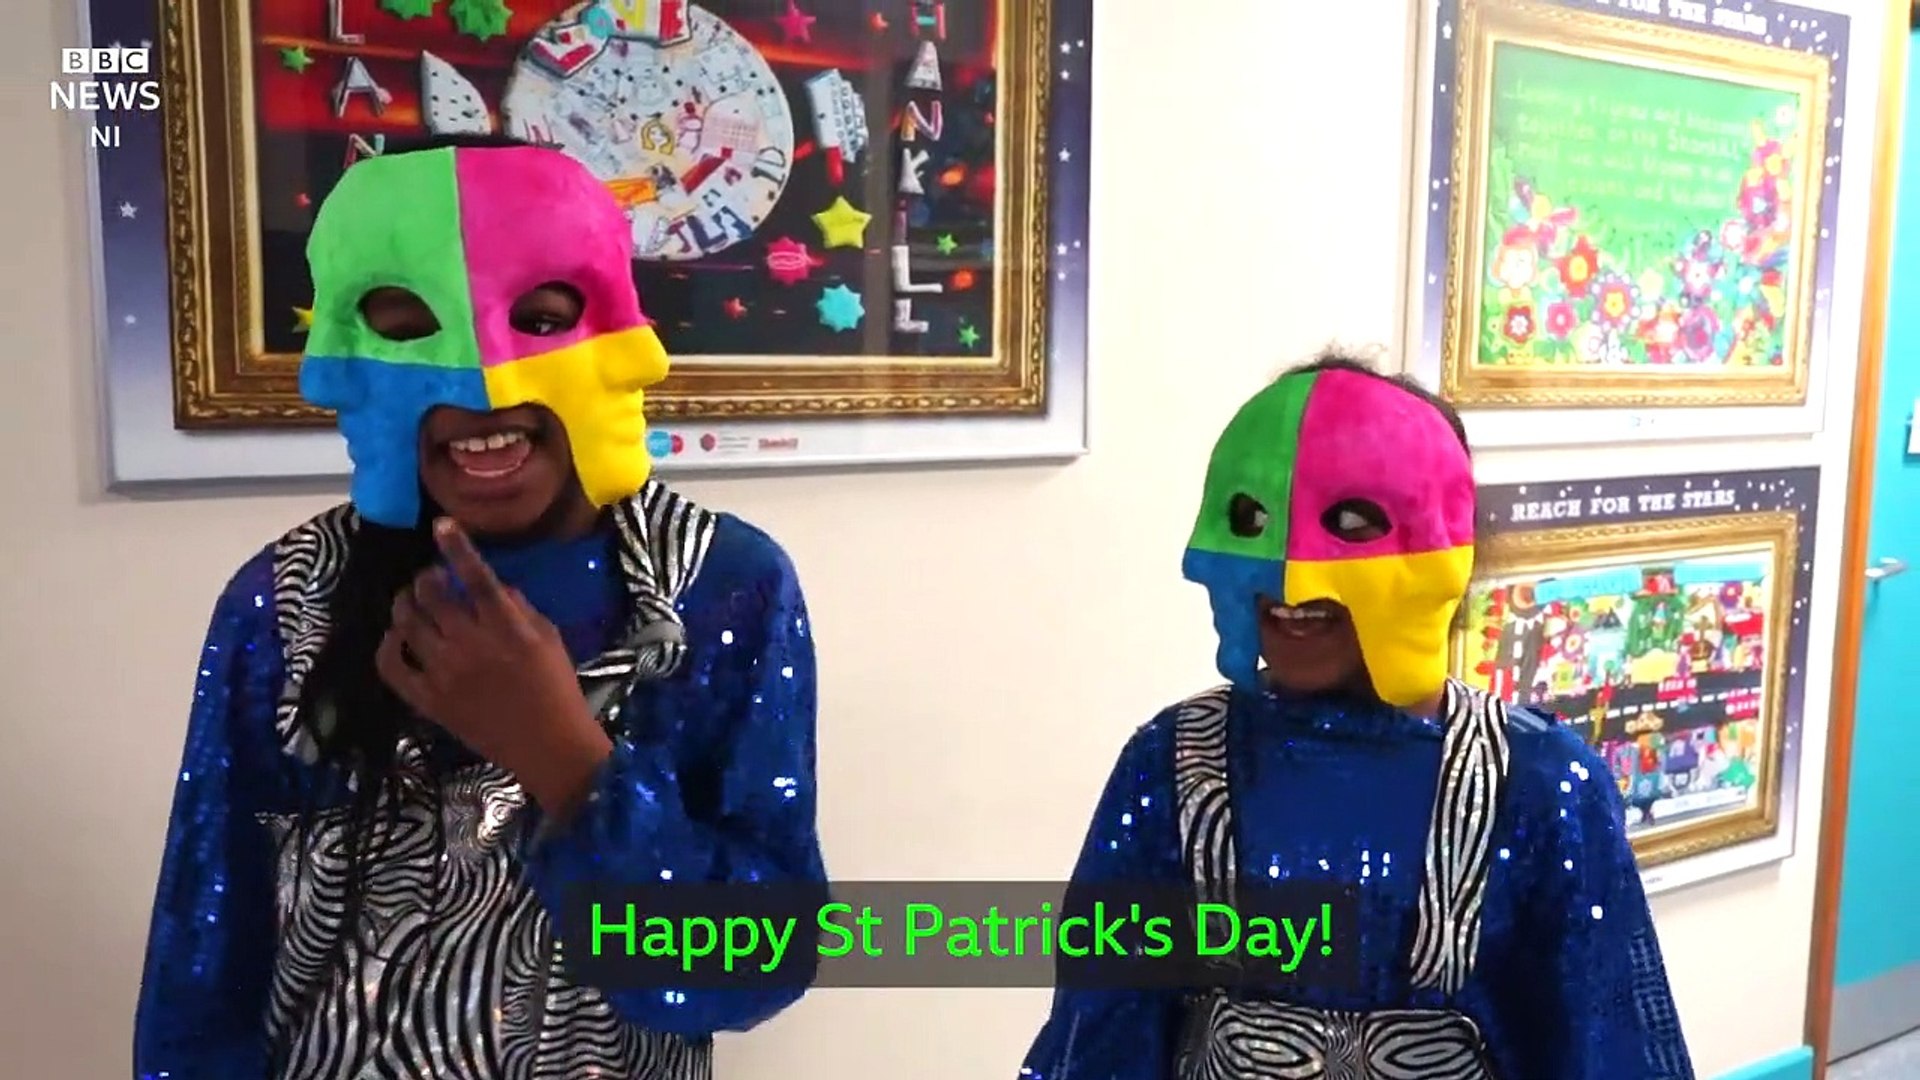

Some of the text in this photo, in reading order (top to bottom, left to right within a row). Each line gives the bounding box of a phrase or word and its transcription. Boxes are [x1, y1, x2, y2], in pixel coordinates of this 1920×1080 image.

[1510, 489, 1736, 523] REACH FOR THE STARS
